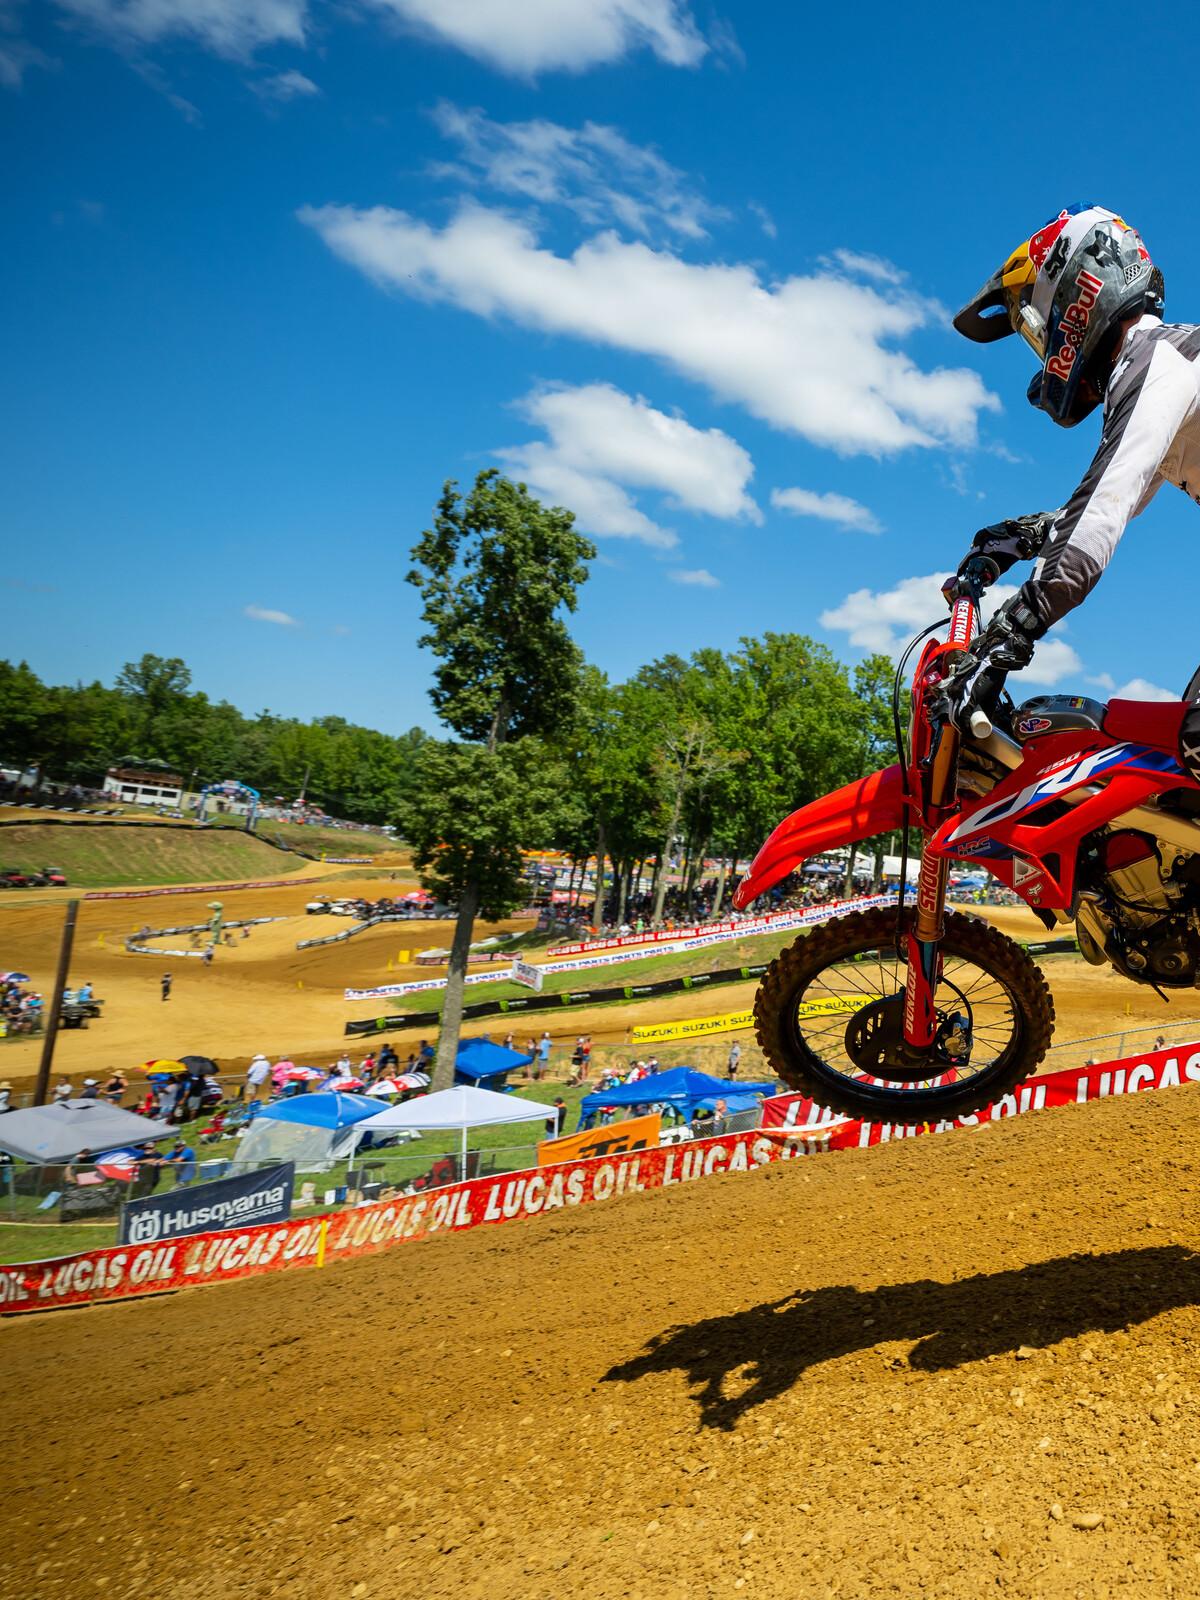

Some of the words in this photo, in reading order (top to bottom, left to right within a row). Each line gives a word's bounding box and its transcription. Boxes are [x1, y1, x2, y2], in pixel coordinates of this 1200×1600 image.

[633, 1027, 678, 1038] SUZUKI
[682, 1020, 726, 1032] SUZUKI
[826, 1000, 867, 1009] SUZUKI
[906, 961, 916, 1034] DUNLOP
[39, 1254, 128, 1298] LUCAS
[130, 1246, 178, 1285] OIL
[183, 1229, 289, 1276] LUCAS
[333, 1200, 427, 1251] LUCAS
[428, 1189, 473, 1233] OIL
[483, 1169, 585, 1222] LUCAS
[593, 1159, 646, 1201] OIL
[662, 1138, 773, 1187] LUCAS
[163, 1186, 284, 1235] Husqvarna
